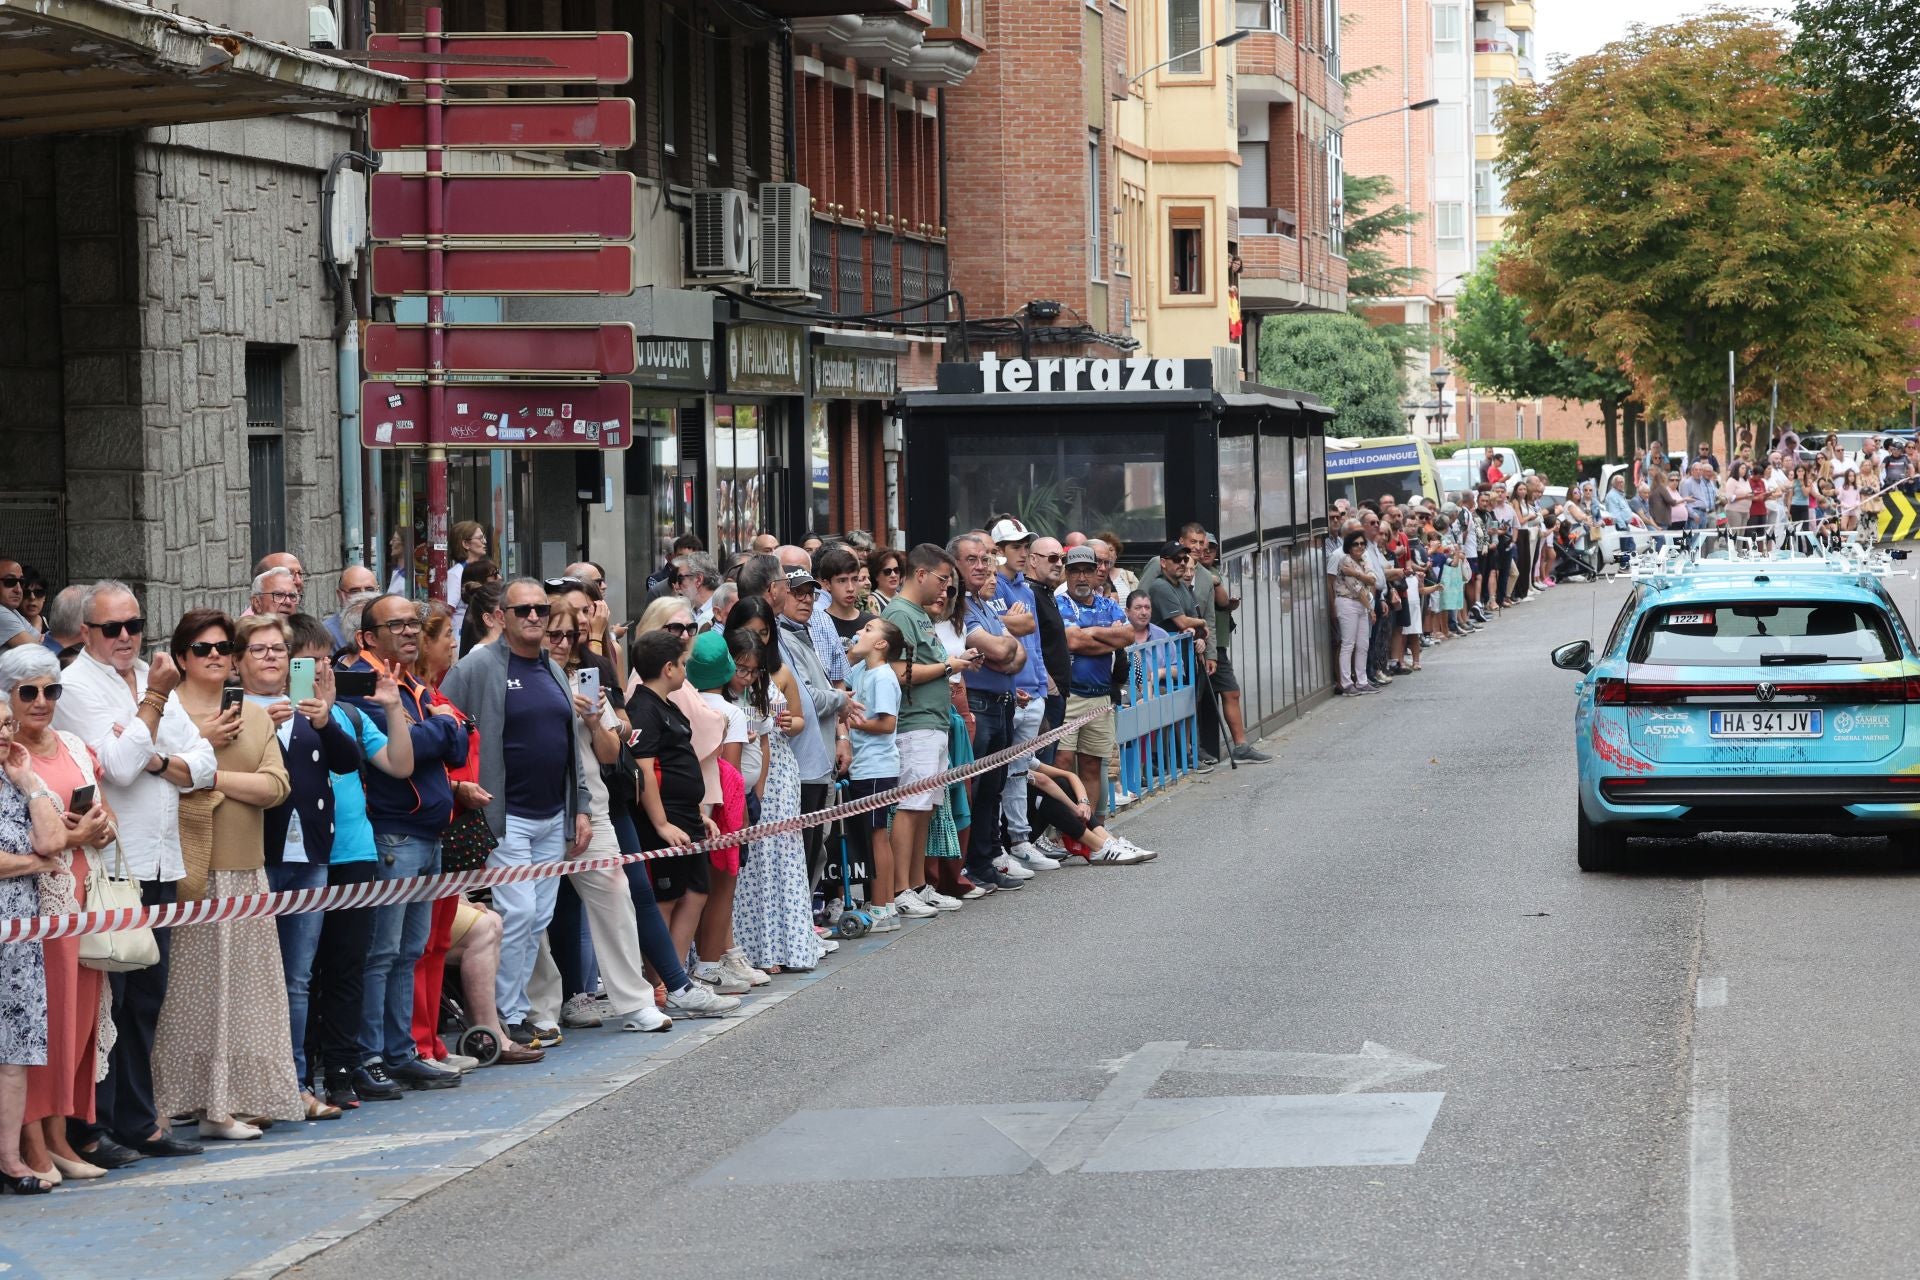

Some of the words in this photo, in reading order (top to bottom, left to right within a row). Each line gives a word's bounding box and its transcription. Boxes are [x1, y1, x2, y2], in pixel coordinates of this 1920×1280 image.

[979, 351, 1185, 393] terraza
[1338, 456, 1366, 467] RUBEN
[1366, 451, 1418, 464] DOMINGUEZ
[1674, 615, 1699, 623] 1222
[1723, 713, 1745, 732] HA
[1752, 713, 1782, 732] 941
[1787, 713, 1808, 732] JV
[1855, 715, 1890, 724] SAMRUK
[1643, 725, 1695, 735] ASTANA
